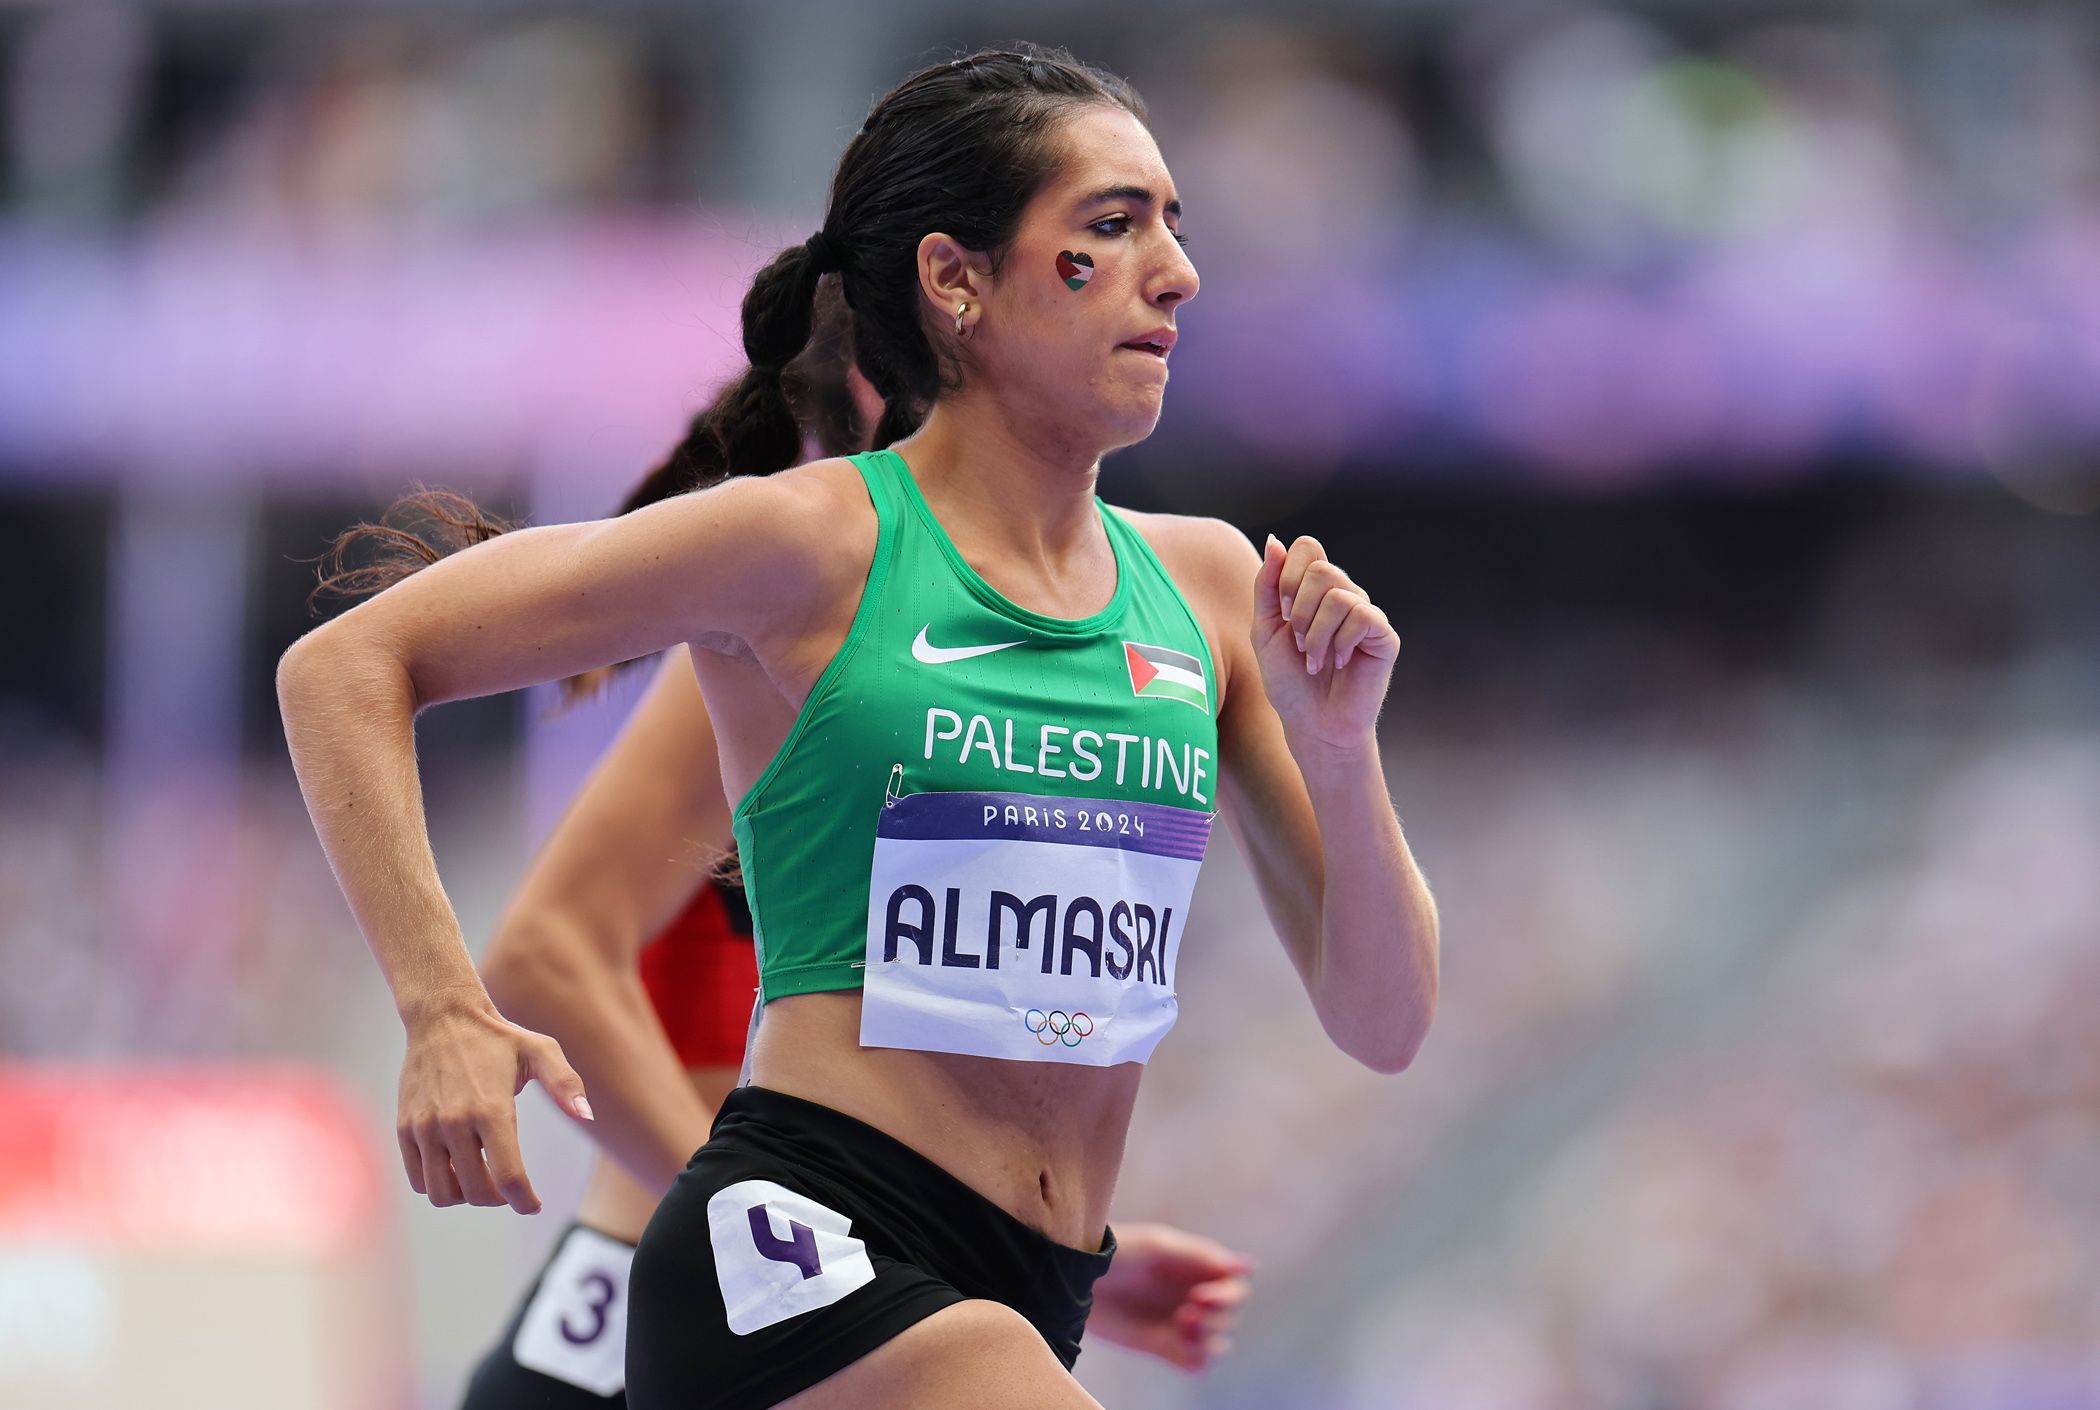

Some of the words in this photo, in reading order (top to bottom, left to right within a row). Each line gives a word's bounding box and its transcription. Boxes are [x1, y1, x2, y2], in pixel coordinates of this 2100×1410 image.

[924, 707, 1210, 805] PALESTINE
[1079, 810, 1145, 836] 2024
[884, 884, 1173, 986] ALMASRI
[747, 1203, 823, 1280] 4
[558, 1266, 616, 1347] 3
